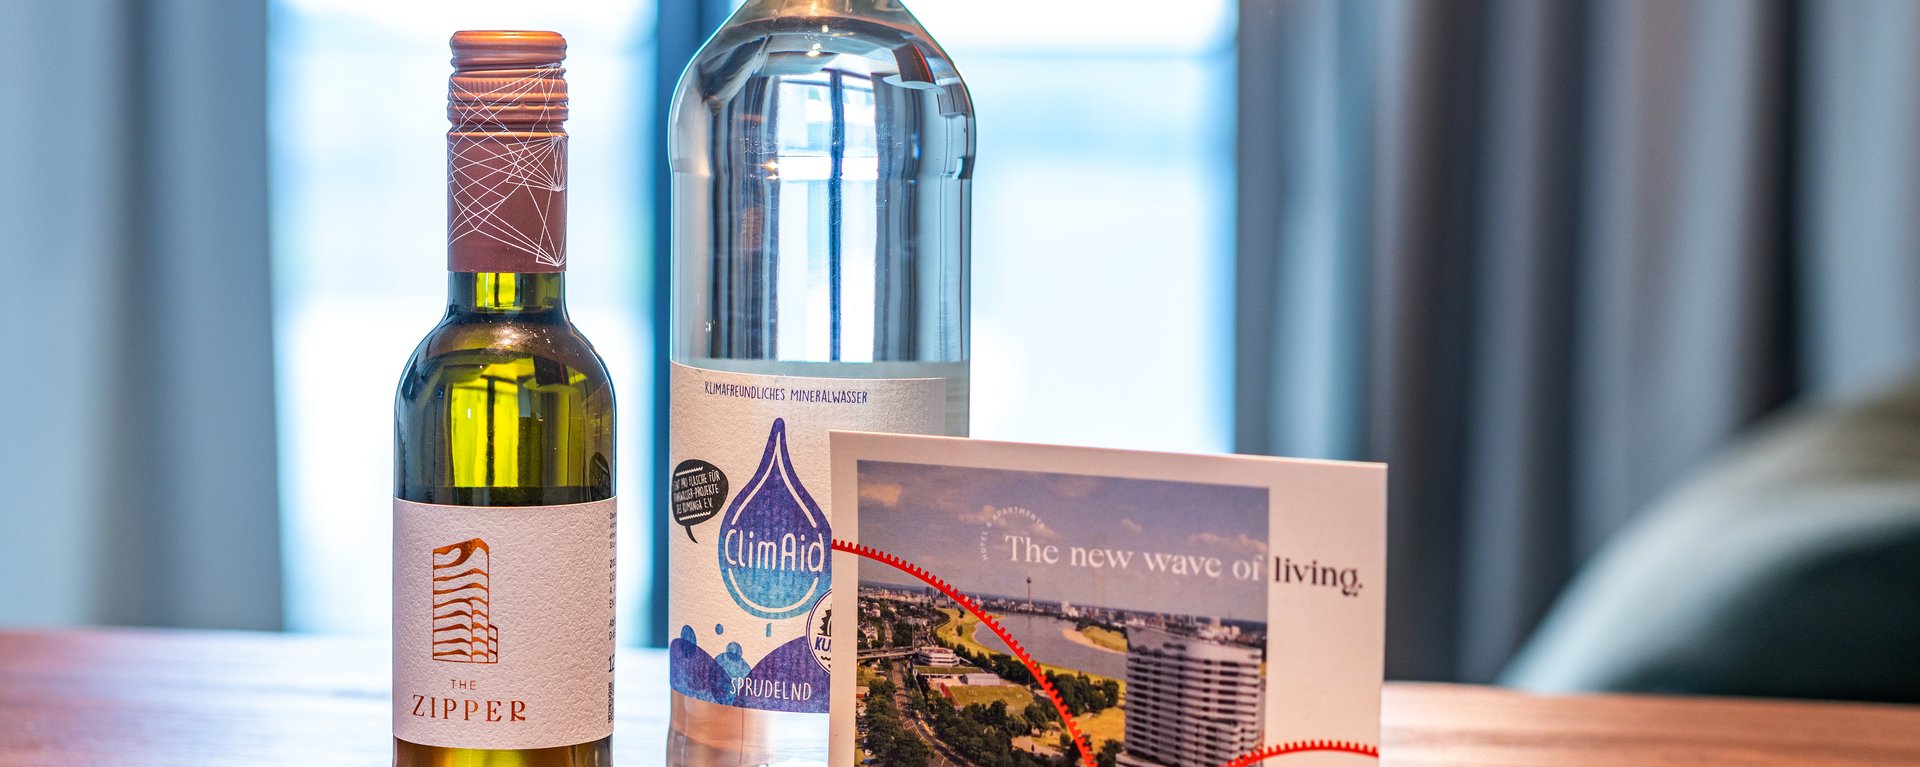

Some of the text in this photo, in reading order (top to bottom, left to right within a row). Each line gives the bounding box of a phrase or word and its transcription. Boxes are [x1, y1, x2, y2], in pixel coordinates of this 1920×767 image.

[705, 381, 868, 404] KLIMAFREUNDLICHES MINERALWASSER
[709, 470, 720, 481] FÜR
[980, 530, 990, 562] HOTEL
[993, 505, 1046, 530] APARTMENTS
[724, 528, 826, 573] ClimAid
[1005, 534, 1364, 597] The new wave of living.
[814, 636, 832, 652] KU
[450, 678, 477, 691] THE
[729, 677, 812, 701] SPRUDELND
[412, 694, 527, 722] ZIPPER
